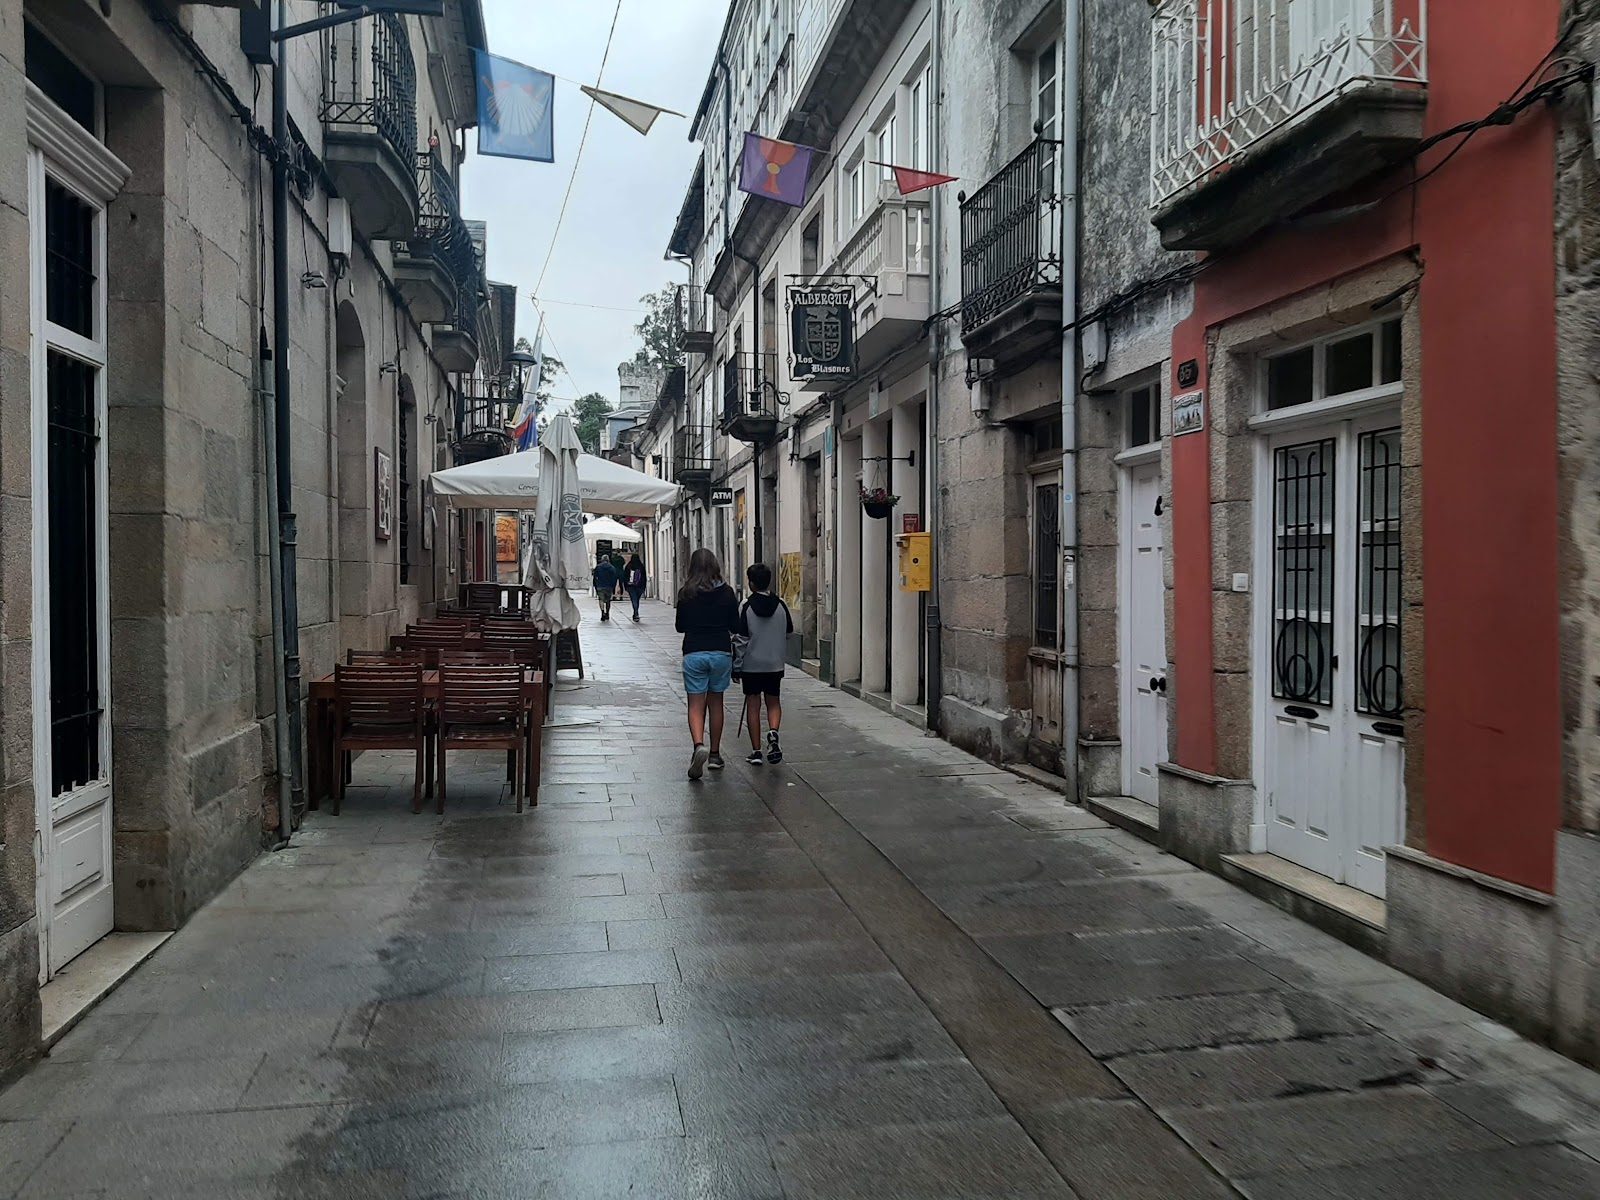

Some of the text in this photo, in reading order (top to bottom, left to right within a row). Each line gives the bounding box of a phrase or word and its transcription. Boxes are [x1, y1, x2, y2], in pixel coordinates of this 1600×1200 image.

[794, 293, 849, 306] ALBERGUE
[797, 354, 813, 364] Los
[811, 364, 850, 373] Blasones
[712, 492, 732, 500] ATM
